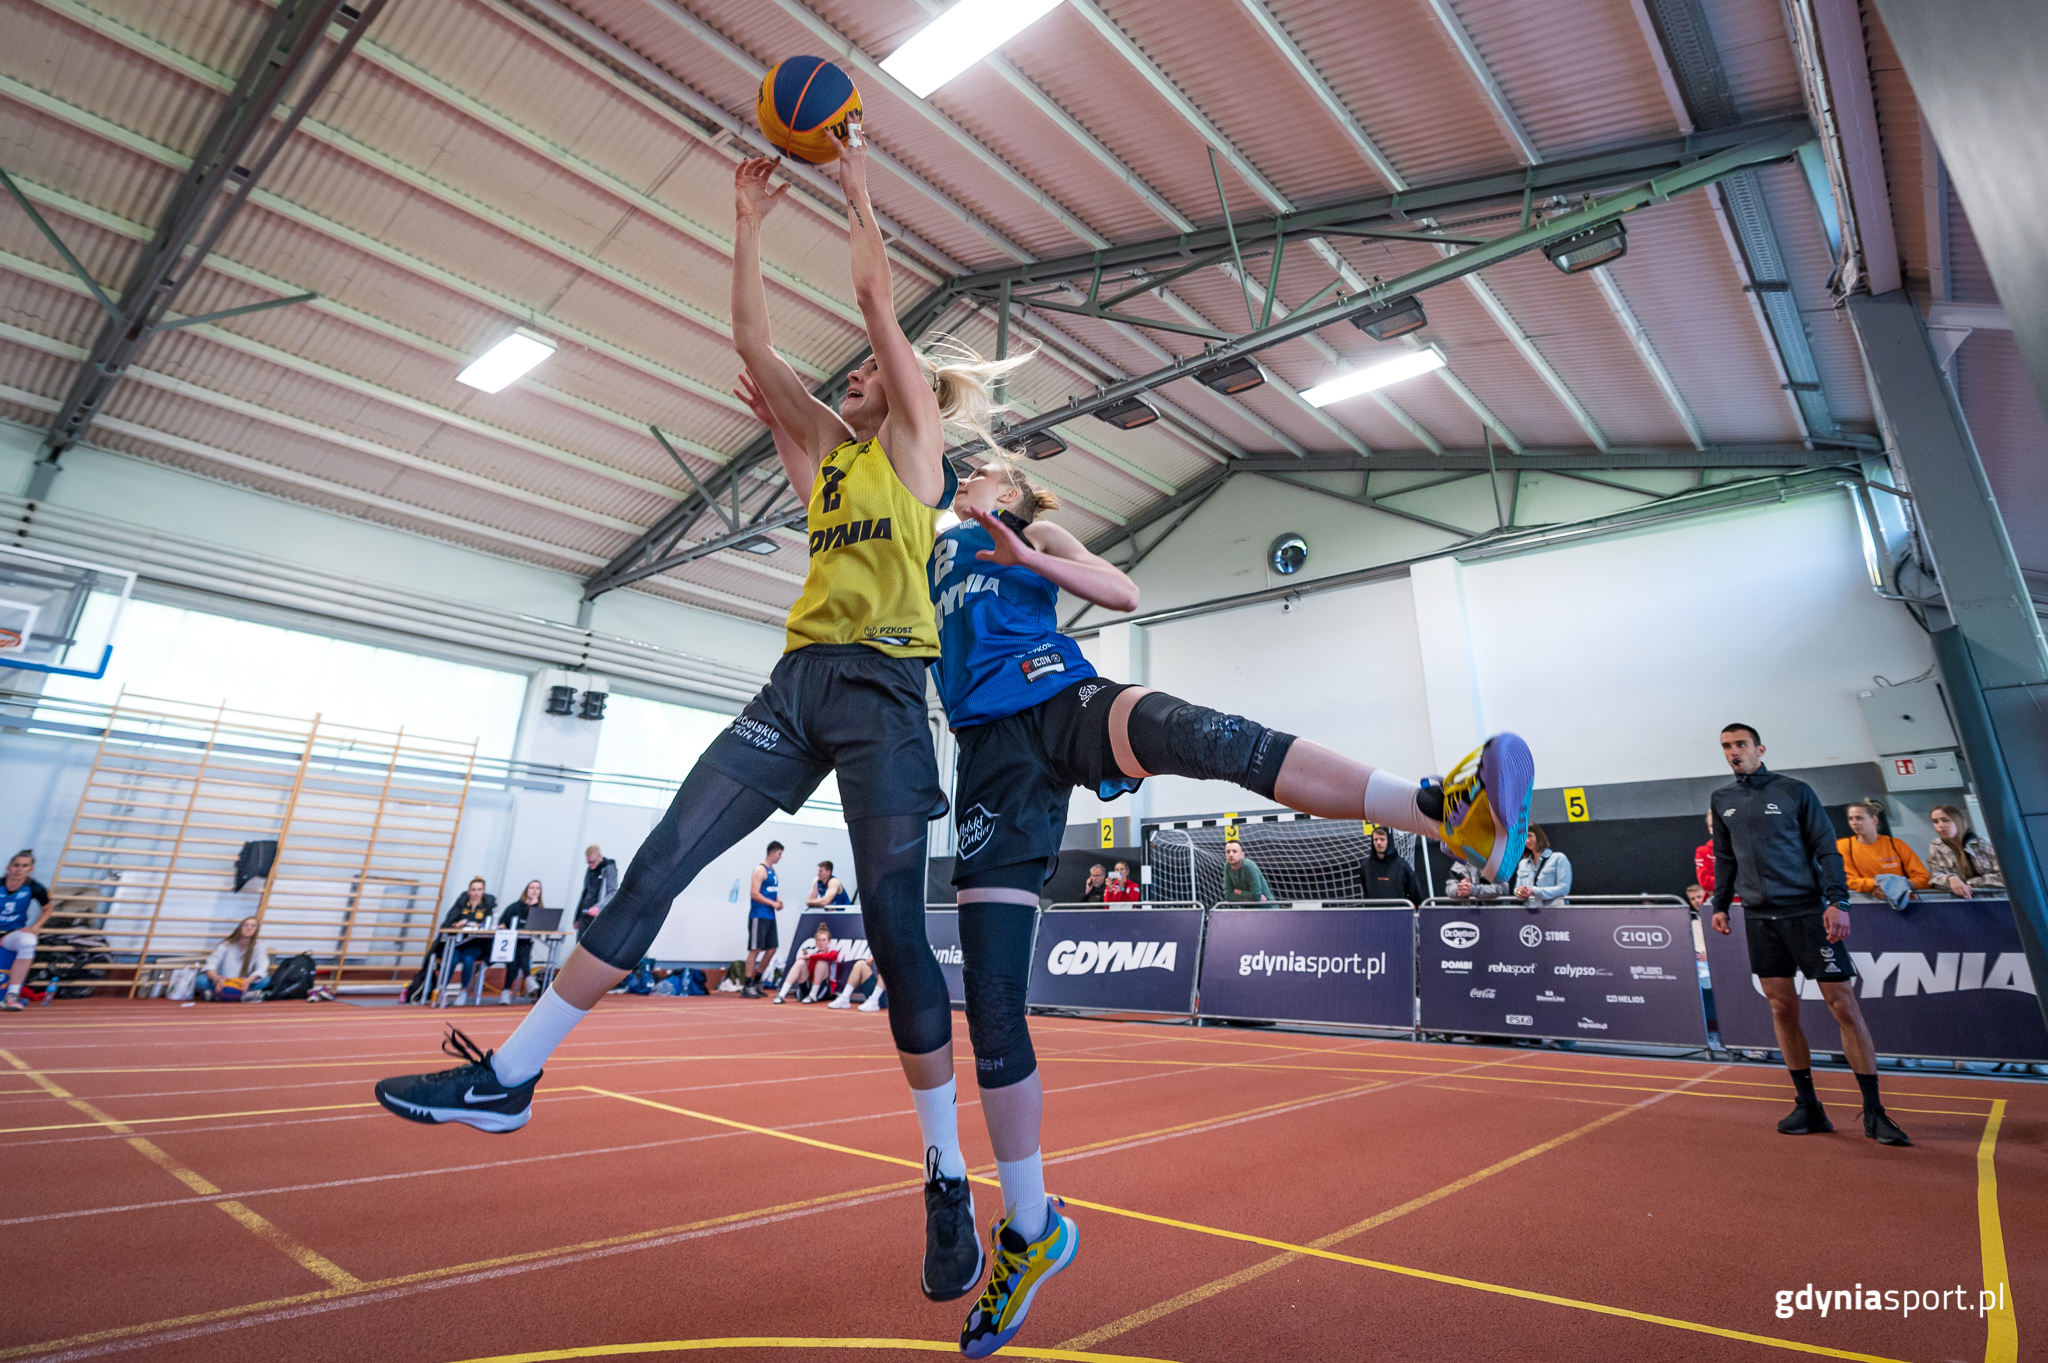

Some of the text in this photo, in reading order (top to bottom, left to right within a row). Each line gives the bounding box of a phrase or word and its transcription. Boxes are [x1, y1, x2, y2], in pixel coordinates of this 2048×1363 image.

[822, 466, 847, 514] 2
[810, 517, 893, 558] DYNIA
[934, 539, 959, 588] 2
[1032, 655, 1052, 668] ICON
[1570, 796, 1585, 818] 5
[1103, 825, 1112, 842] 2
[1545, 931, 1571, 942] STORE
[1621, 931, 1663, 946] ziaja
[500, 939, 509, 952] 2
[1047, 939, 1178, 976] GDYNIA
[1238, 949, 1386, 980] gdyniasport.pl
[1488, 962, 1535, 976] rehasport
[1554, 963, 1596, 978] calypso
[1617, 995, 1645, 1004] HELIOS
